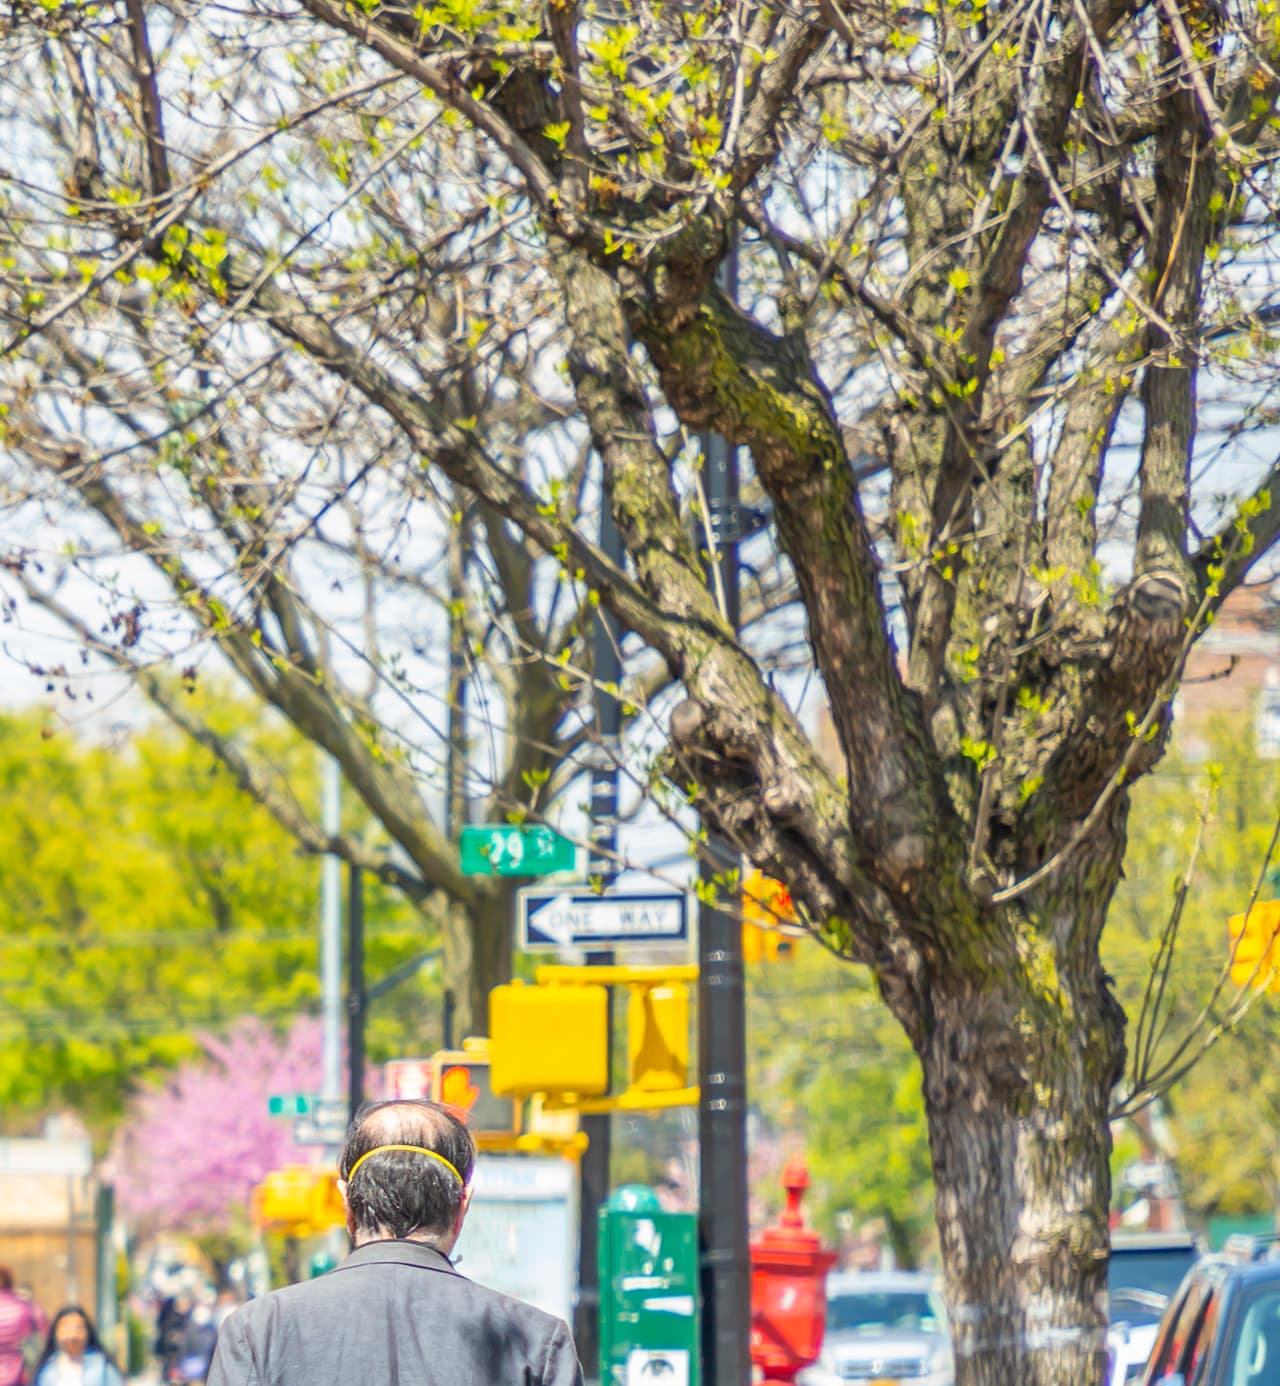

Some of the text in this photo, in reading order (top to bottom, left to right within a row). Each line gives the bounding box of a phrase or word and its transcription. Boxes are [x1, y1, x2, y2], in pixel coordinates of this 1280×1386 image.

[489, 831, 525, 869] 29
[548, 906, 668, 931] ONE WAY
